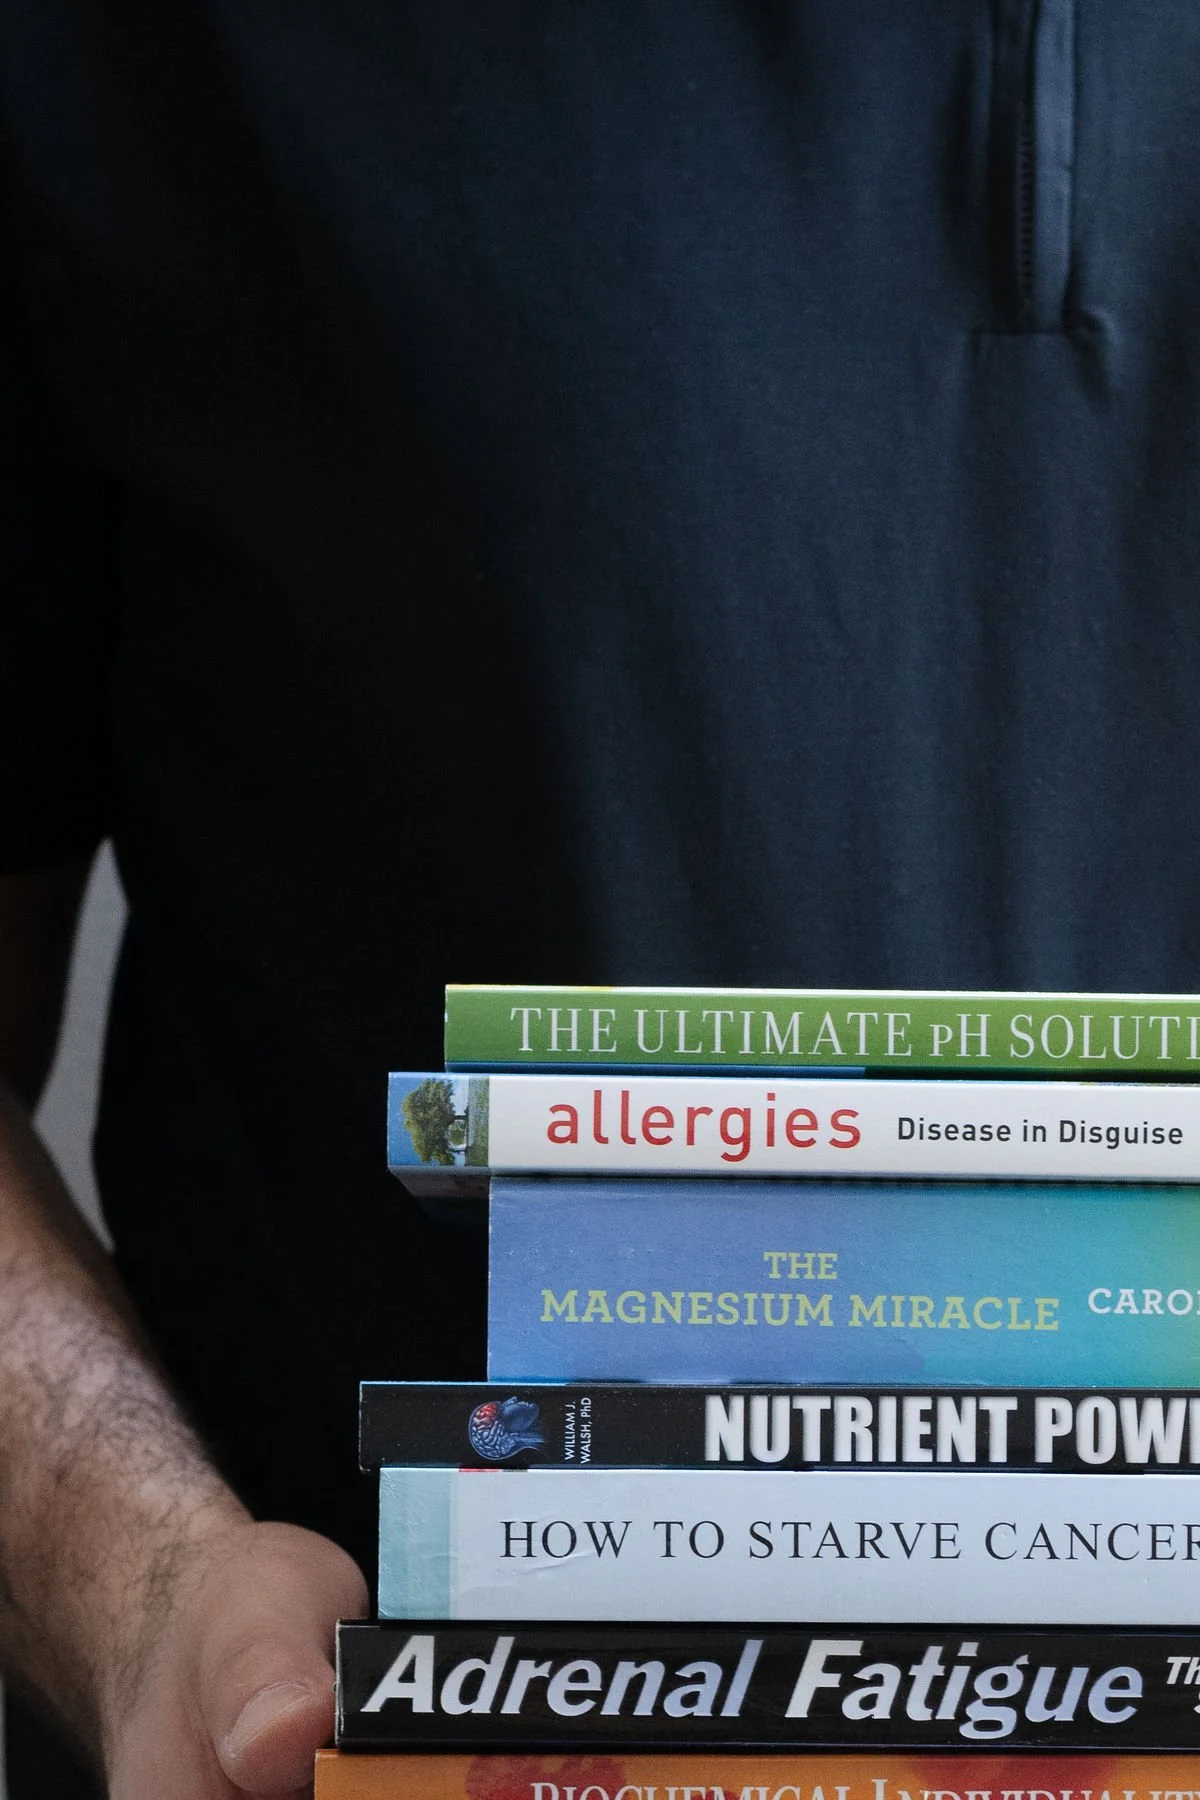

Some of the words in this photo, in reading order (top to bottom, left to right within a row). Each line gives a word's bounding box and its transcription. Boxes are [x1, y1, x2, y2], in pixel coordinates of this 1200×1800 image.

[511, 1007, 617, 1052] THE
[636, 1009, 912, 1057] ULTIMATE
[546, 1089, 861, 1162] allergies
[898, 1118, 1011, 1143] Disease
[1022, 1119, 1048, 1143] in
[1059, 1121, 1184, 1148] Disguise
[763, 1252, 838, 1280] THE
[540, 1290, 834, 1326] MAGNESIUM
[848, 1295, 1060, 1331] MIRACLE
[581, 1398, 591, 1417] PhD
[565, 1413, 575, 1460] WILLIAM
[581, 1422, 592, 1463] WALSH,
[704, 1396, 1018, 1464] NUTRIENT
[500, 1520, 632, 1559] HOW
[653, 1520, 726, 1559] TO
[749, 1521, 962, 1561] STARVE
[361, 1635, 764, 1718] Adrenal
[784, 1639, 1142, 1739] Fatigue
